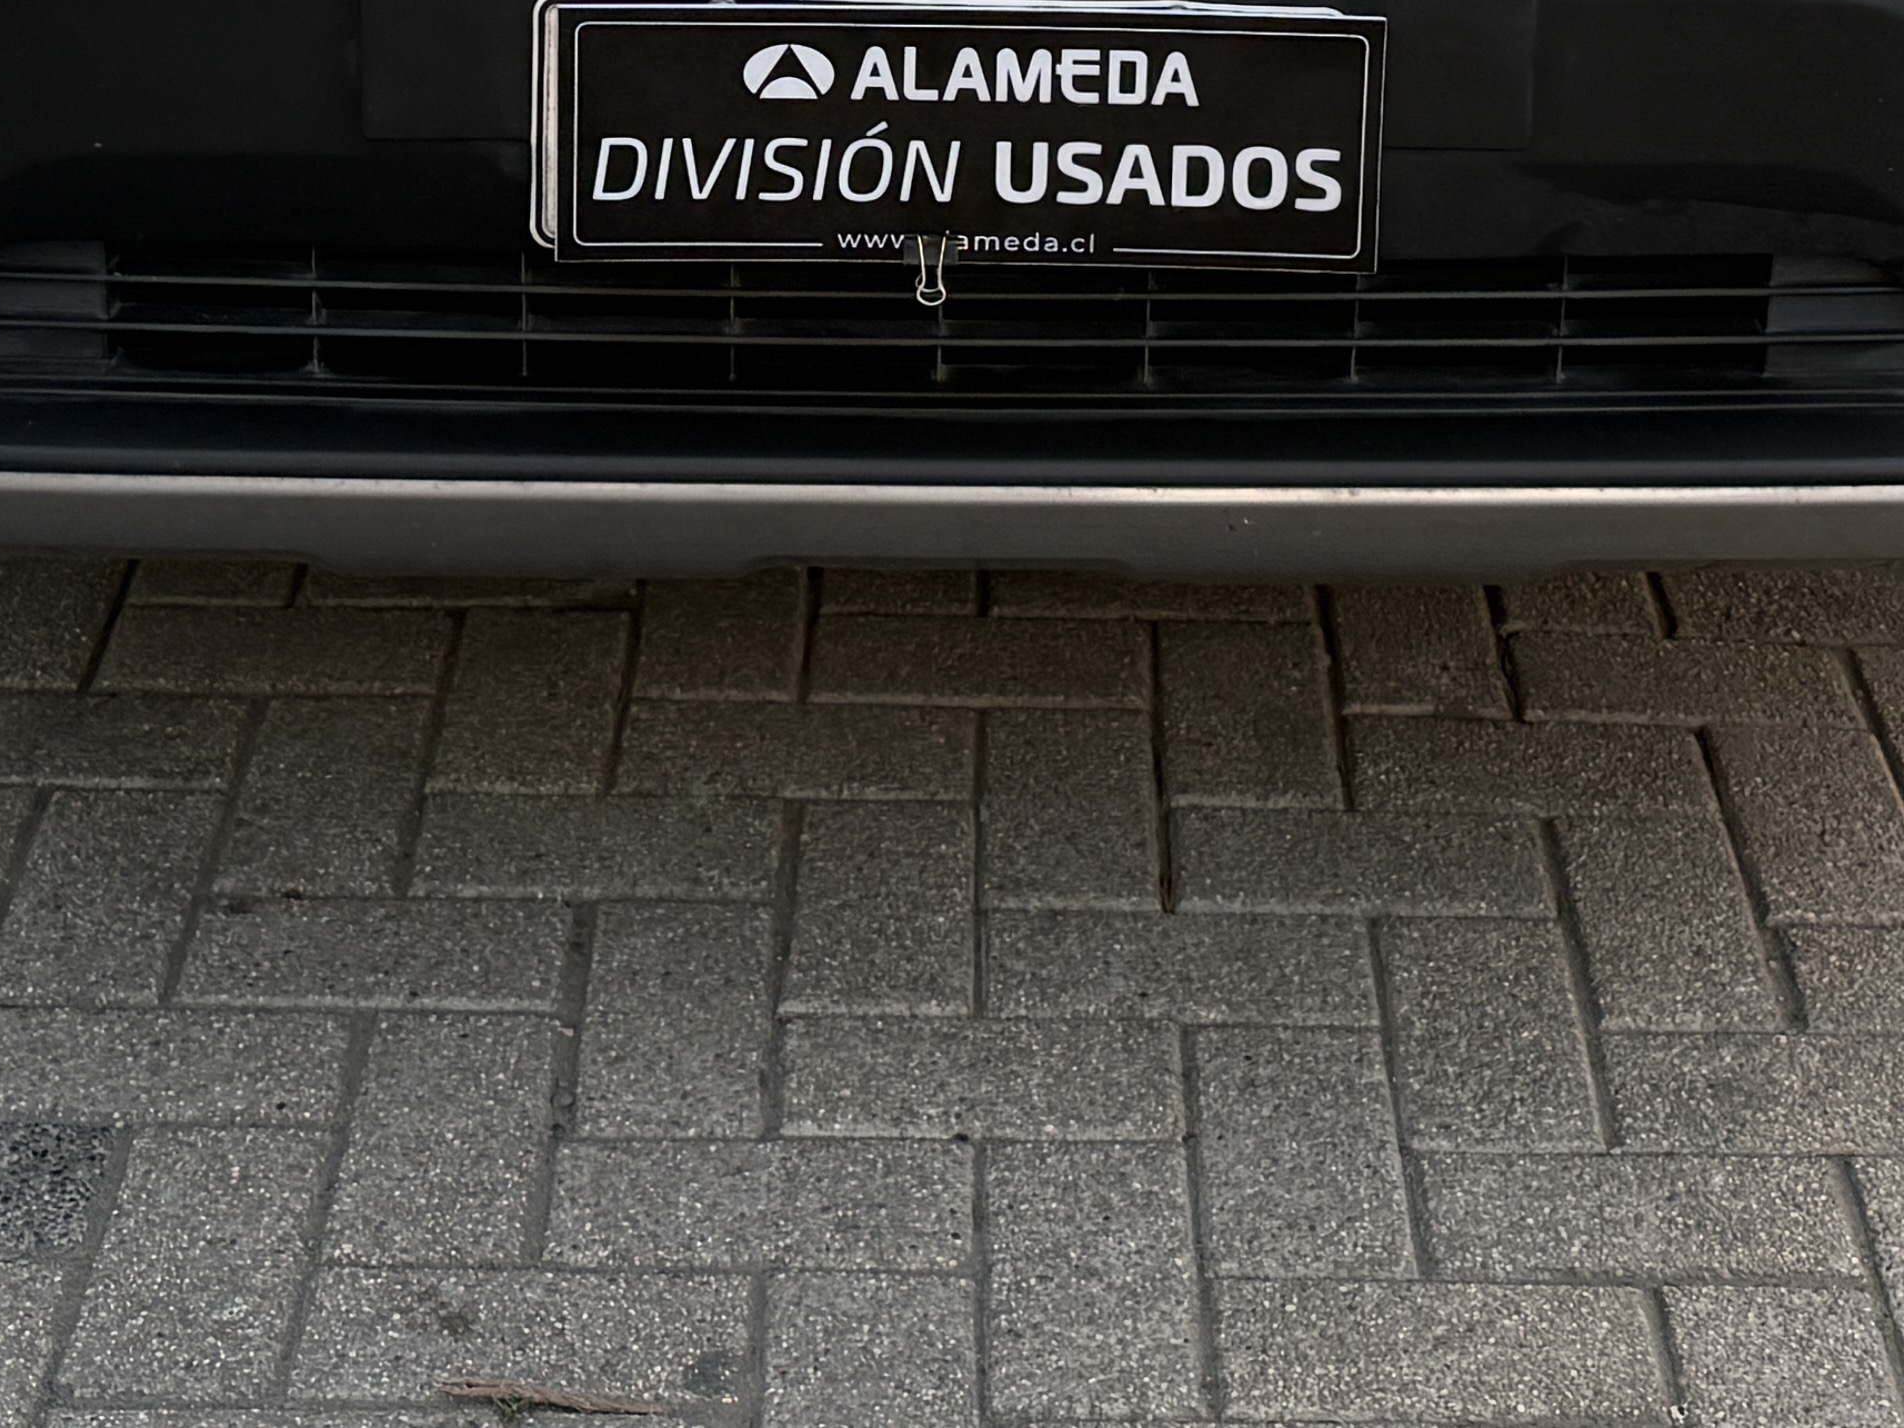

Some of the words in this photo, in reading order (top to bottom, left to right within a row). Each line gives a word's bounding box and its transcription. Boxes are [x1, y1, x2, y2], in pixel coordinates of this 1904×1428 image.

[850, 45, 1200, 107] ALAMEDA
[591, 121, 962, 203] DIVISIÓN
[994, 142, 1343, 213] USADOS
